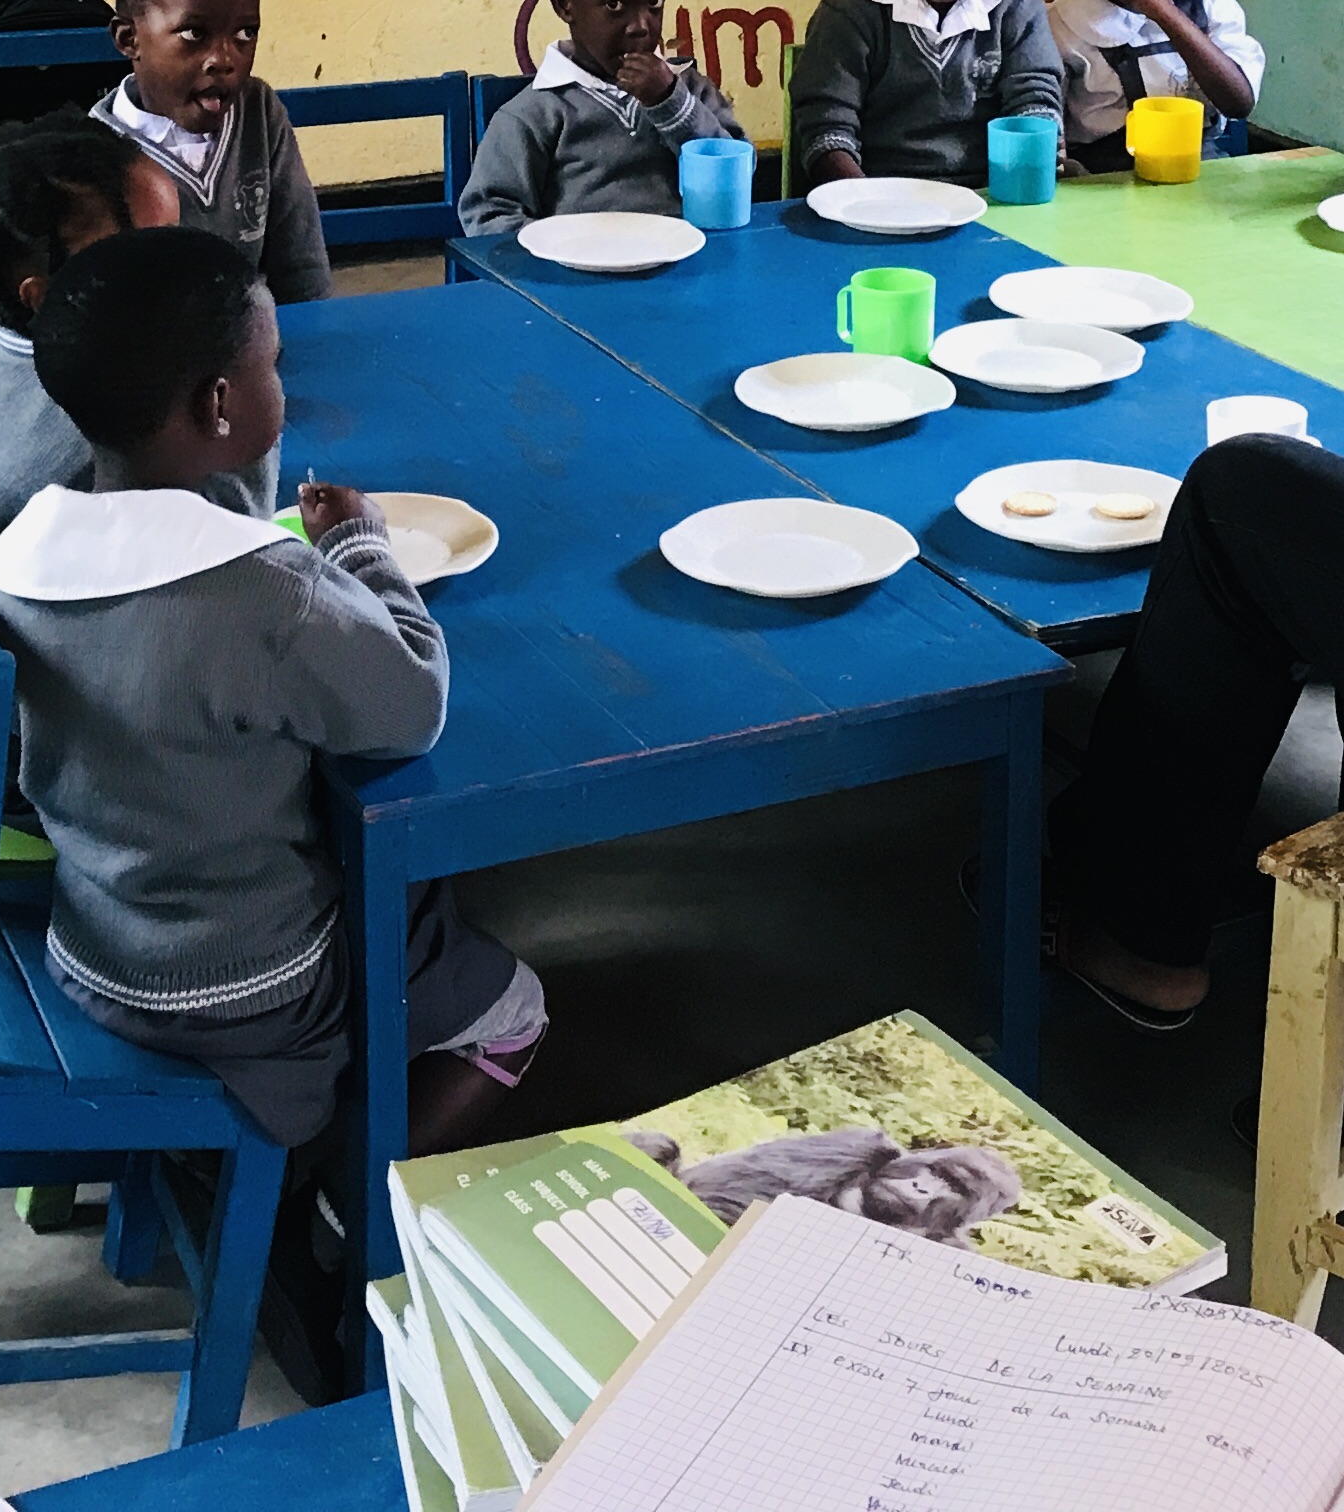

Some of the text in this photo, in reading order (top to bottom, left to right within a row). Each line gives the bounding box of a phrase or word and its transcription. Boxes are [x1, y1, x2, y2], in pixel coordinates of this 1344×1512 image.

[529, 1178, 569, 1212] SUBJECT
[555, 1168, 591, 1200] SCHOOL
[503, 1189, 534, 1216] CLASS
